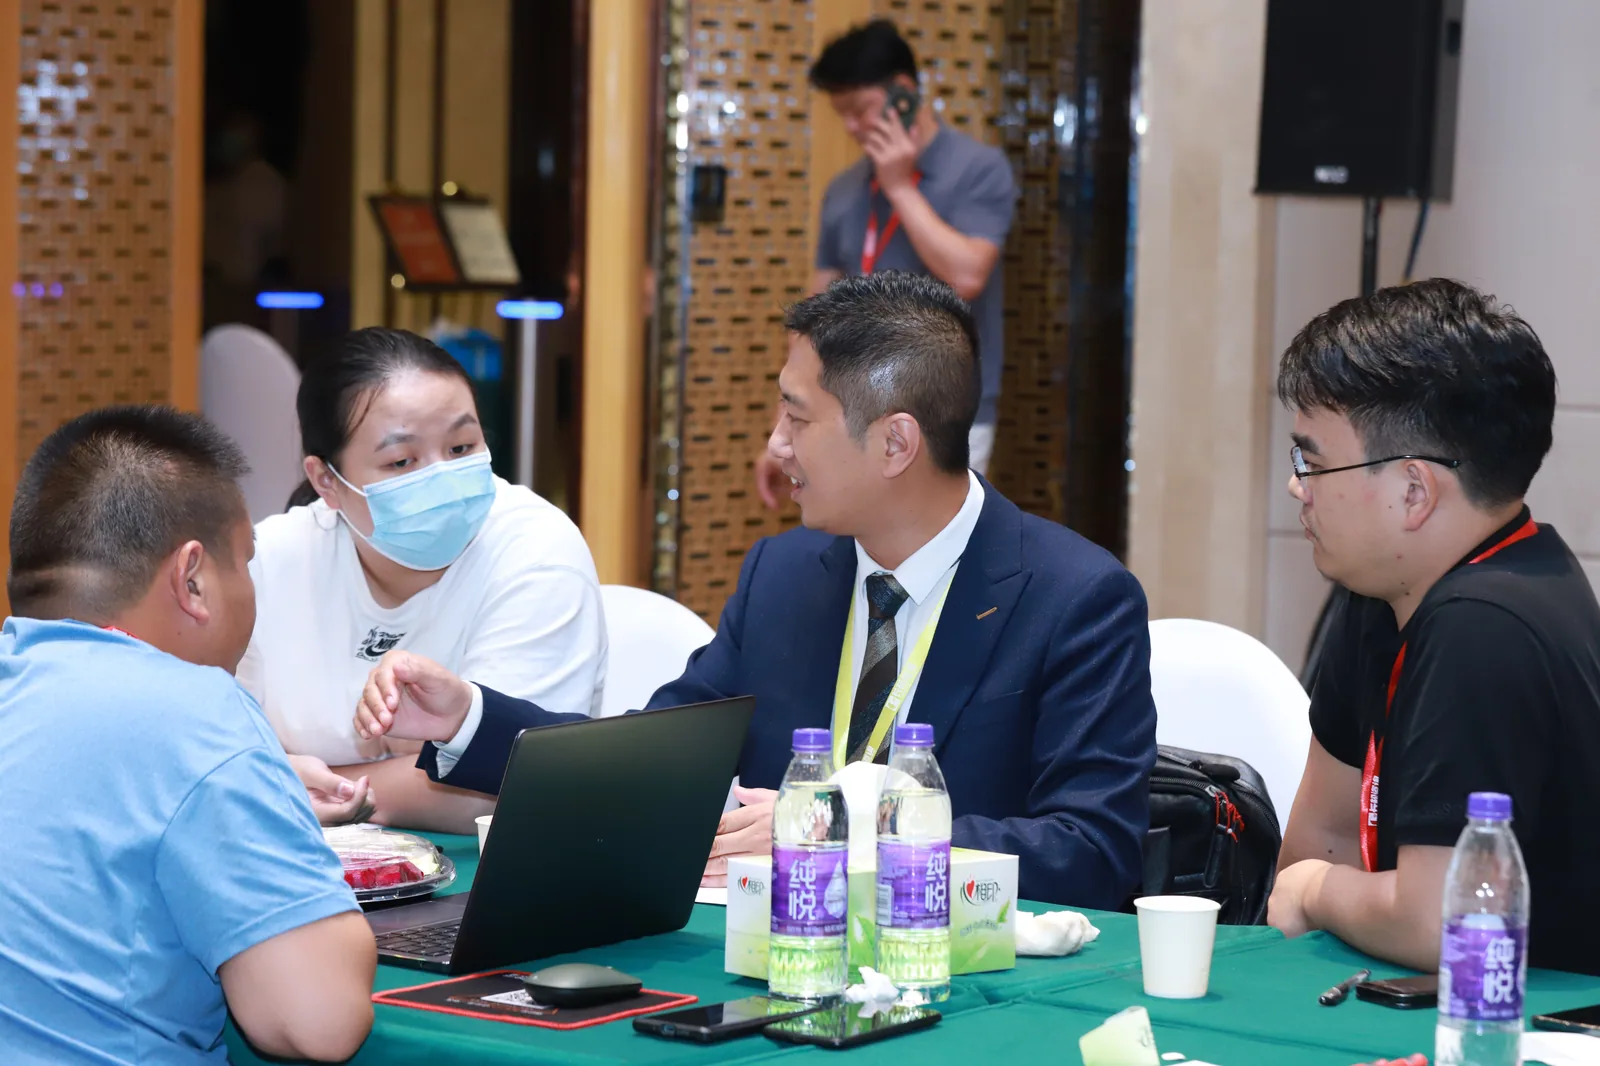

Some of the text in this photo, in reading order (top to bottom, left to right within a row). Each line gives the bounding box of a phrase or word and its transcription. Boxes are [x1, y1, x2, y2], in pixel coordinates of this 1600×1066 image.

[789, 858, 817, 920] 纯悦
[925, 850, 947, 912] 纯悦
[1482, 936, 1516, 1004] 纯悦
